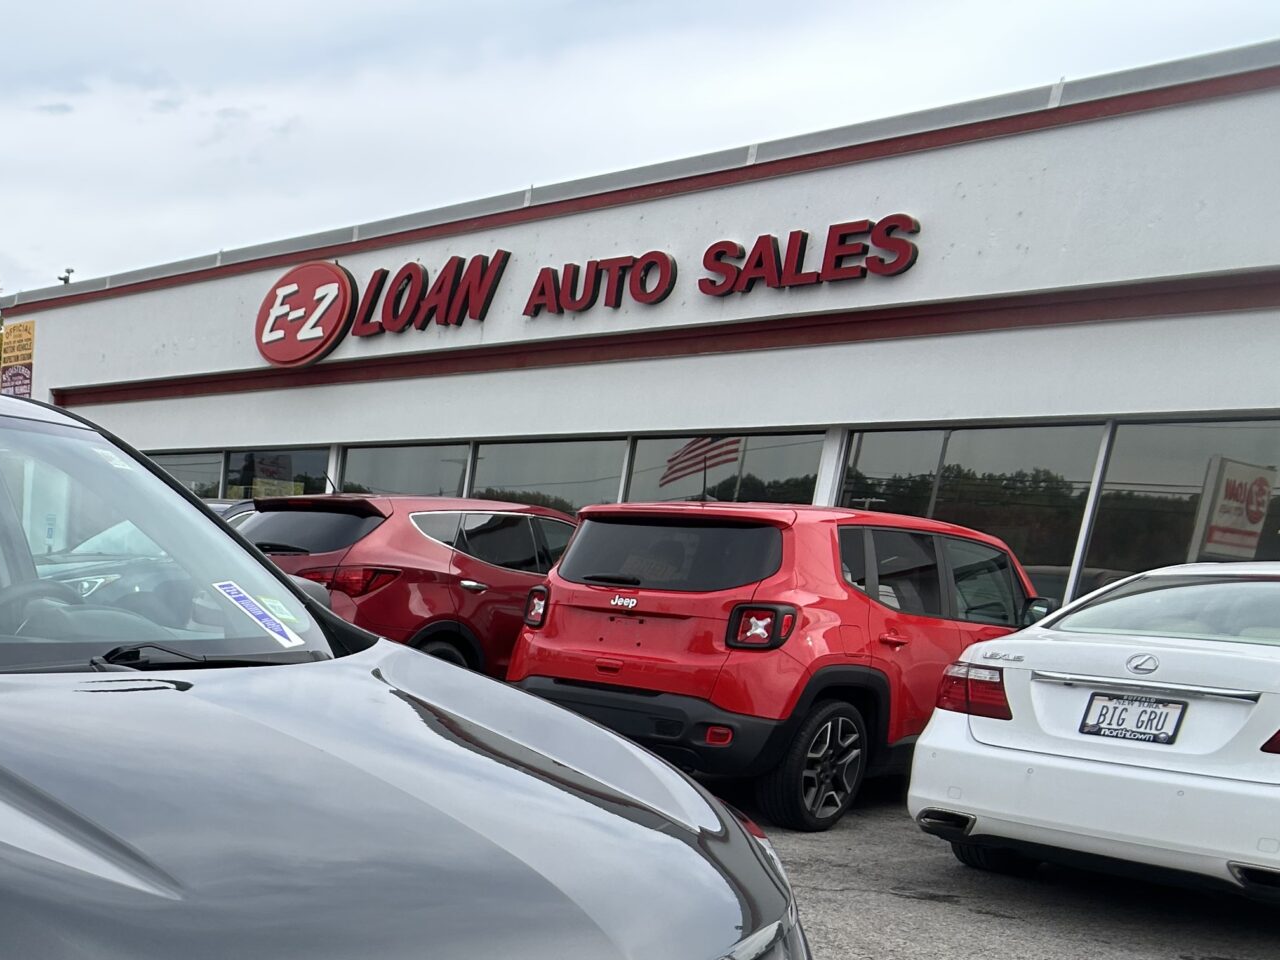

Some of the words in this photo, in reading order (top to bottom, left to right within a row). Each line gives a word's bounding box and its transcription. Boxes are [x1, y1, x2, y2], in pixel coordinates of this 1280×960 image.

[261, 282, 339, 343] E-Z
[351, 248, 512, 338] LOAN
[522, 250, 678, 318] AUTO
[697, 213, 922, 298] SALES
[610, 594, 637, 608] Jeep
[1115, 699, 1134, 707] NEW
[1138, 702, 1161, 710] YORK
[1123, 695, 1156, 703] BUFFALO
[1096, 704, 1128, 727] BIG
[1135, 709, 1169, 732] GRU
[1100, 727, 1154, 741] northtown
